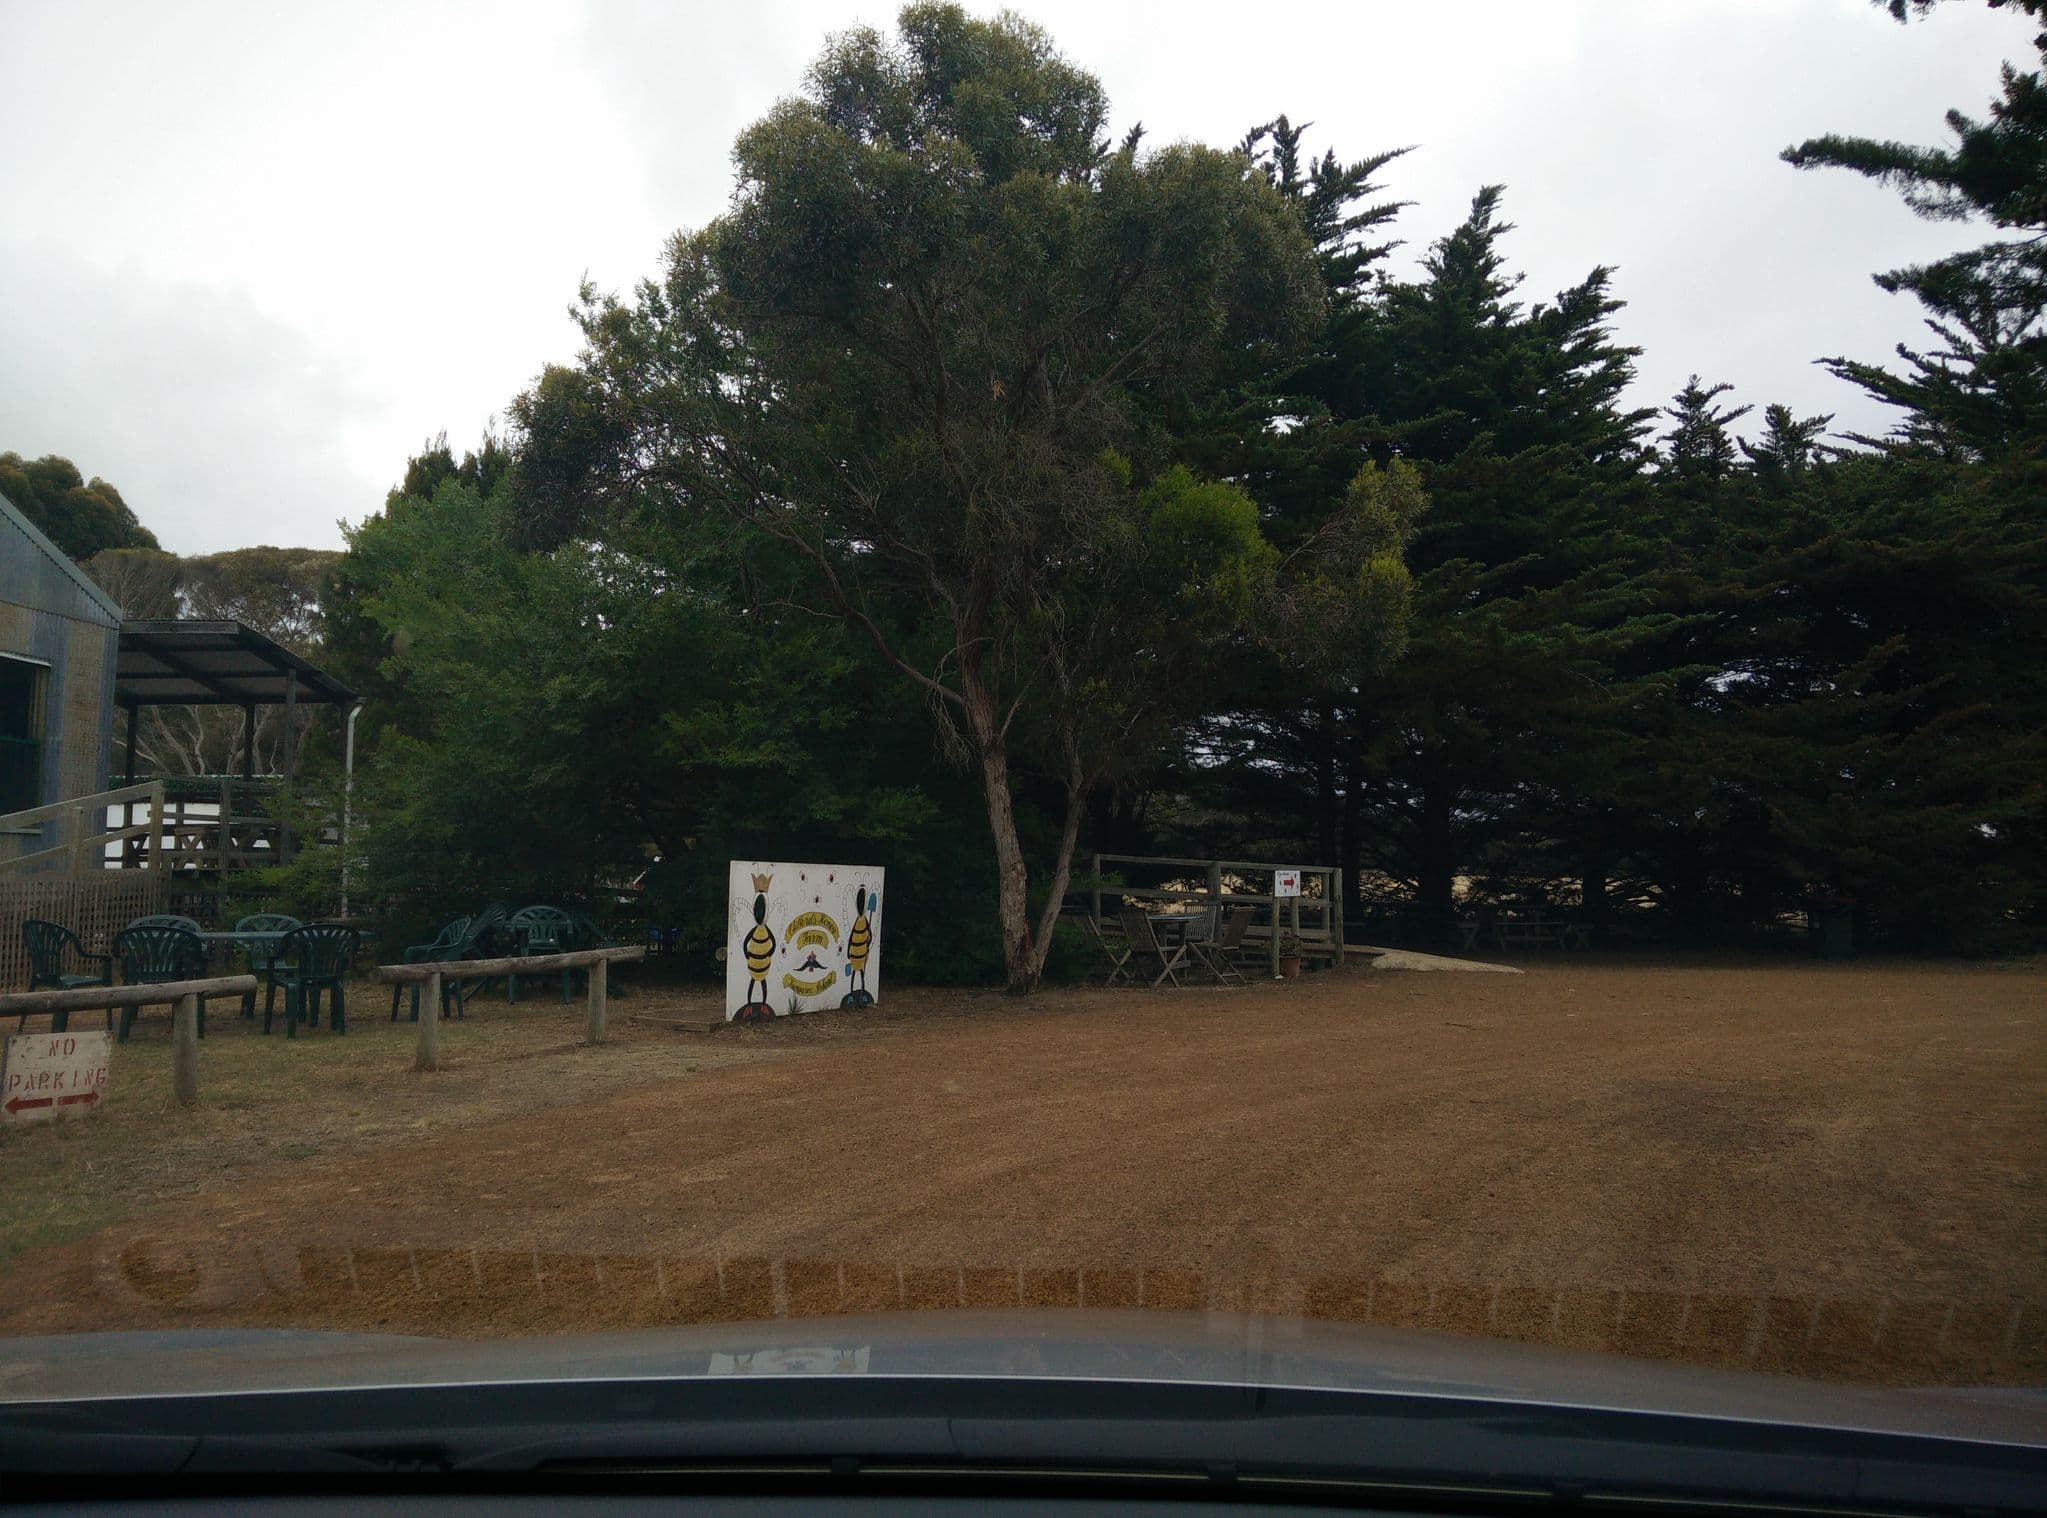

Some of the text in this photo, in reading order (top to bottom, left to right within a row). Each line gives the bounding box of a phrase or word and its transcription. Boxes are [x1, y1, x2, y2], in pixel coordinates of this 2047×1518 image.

[802, 932, 824, 944] Farm
[48, 1038, 76, 1056] NO
[8, 1067, 107, 1092] PARKING
